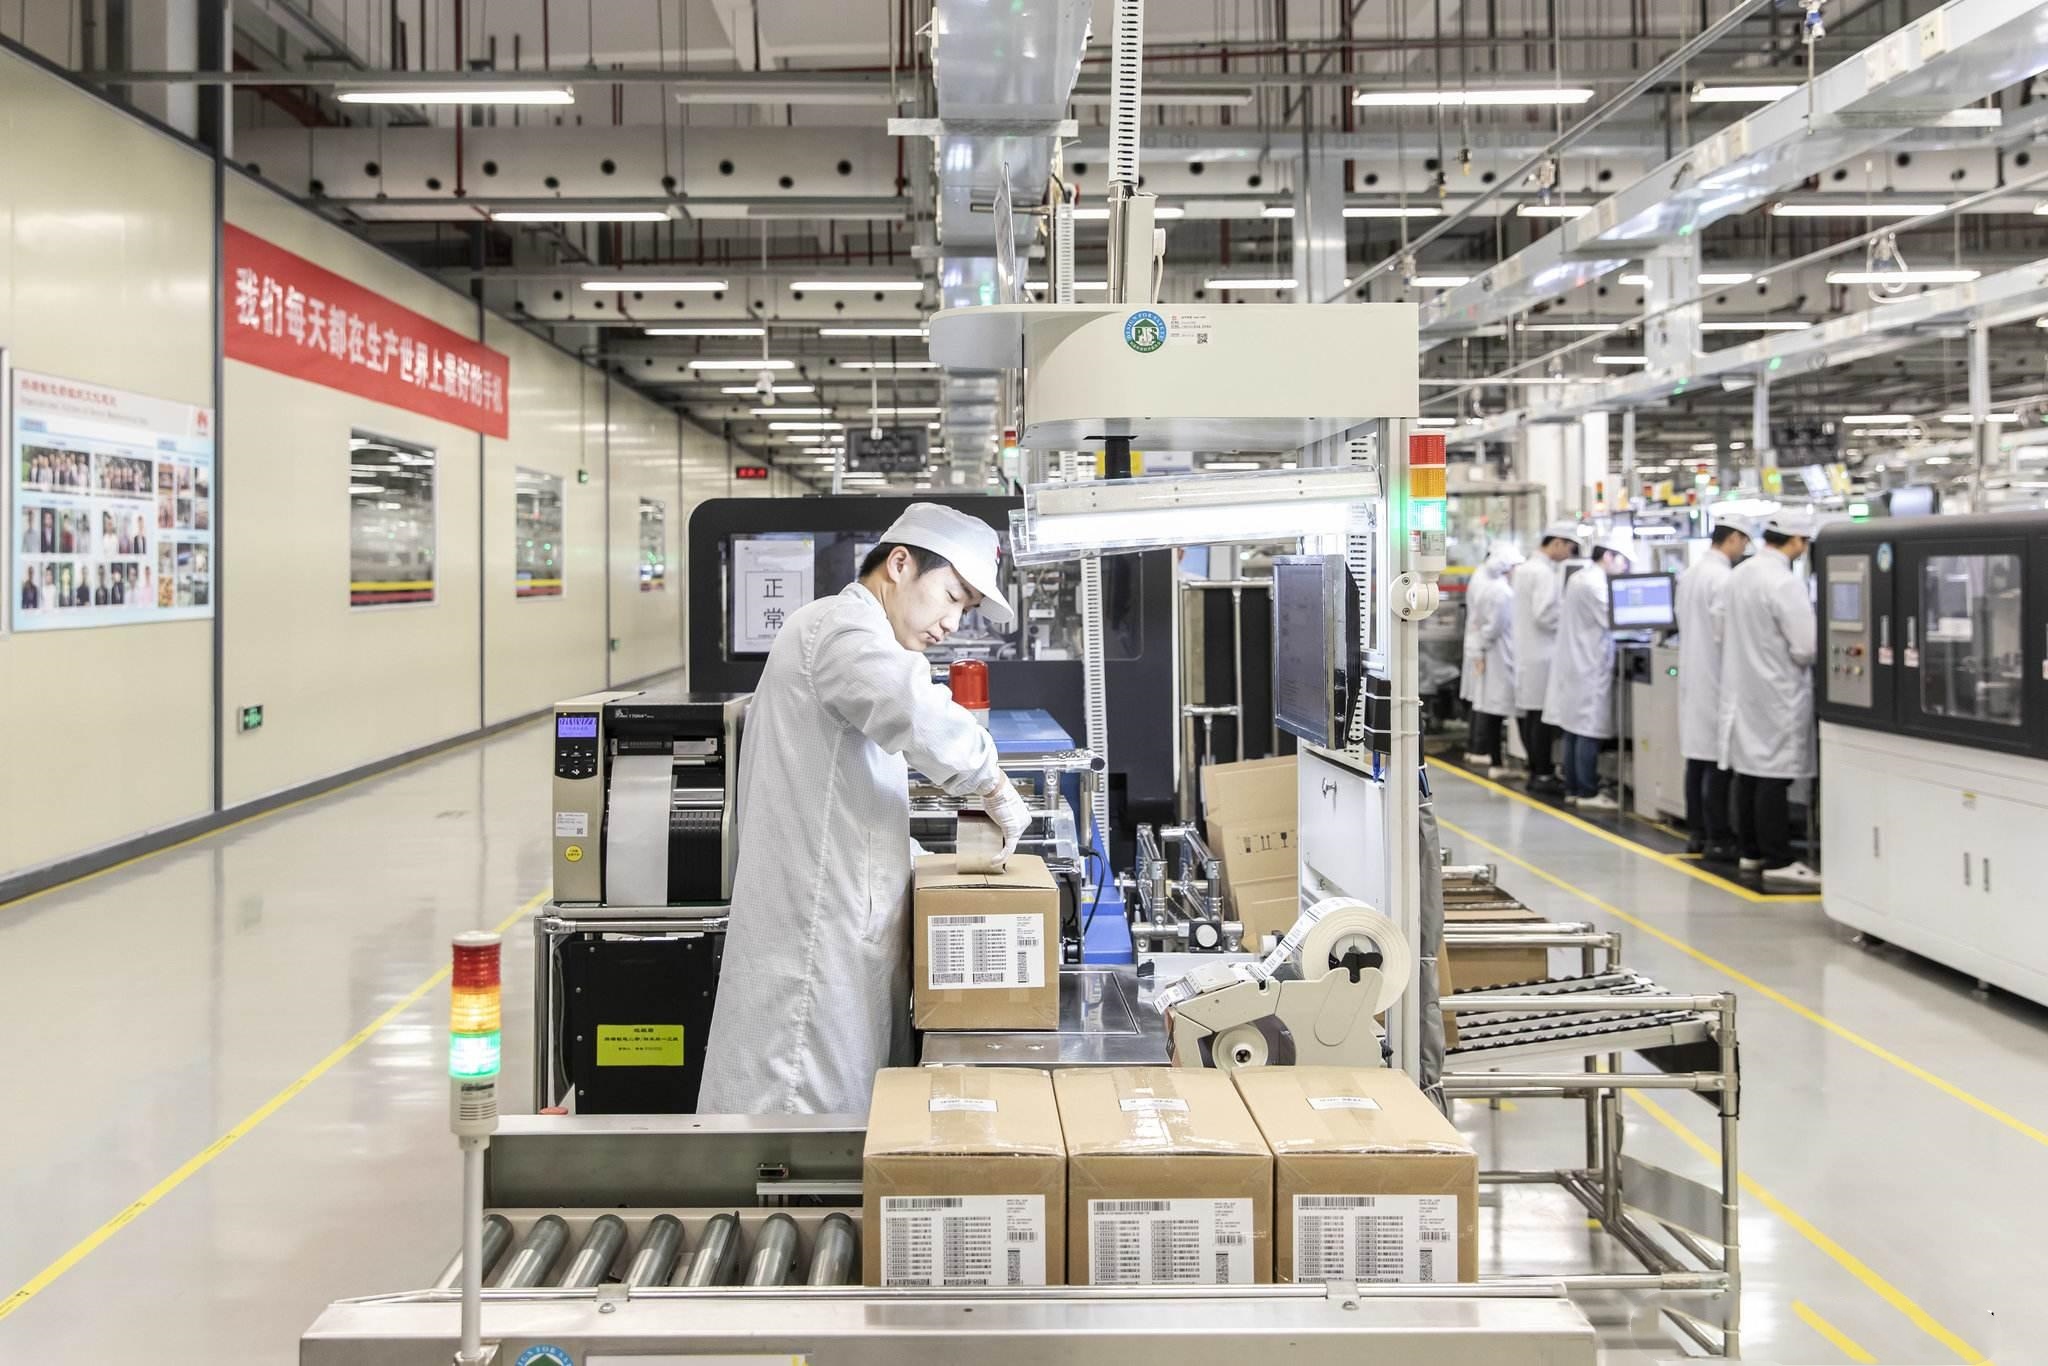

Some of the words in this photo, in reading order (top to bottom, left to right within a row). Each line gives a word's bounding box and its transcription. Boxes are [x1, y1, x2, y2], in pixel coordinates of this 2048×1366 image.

[235, 266, 504, 415] 我们每天都在生产世界上最好的手机
[762, 578, 785, 630] 正常
